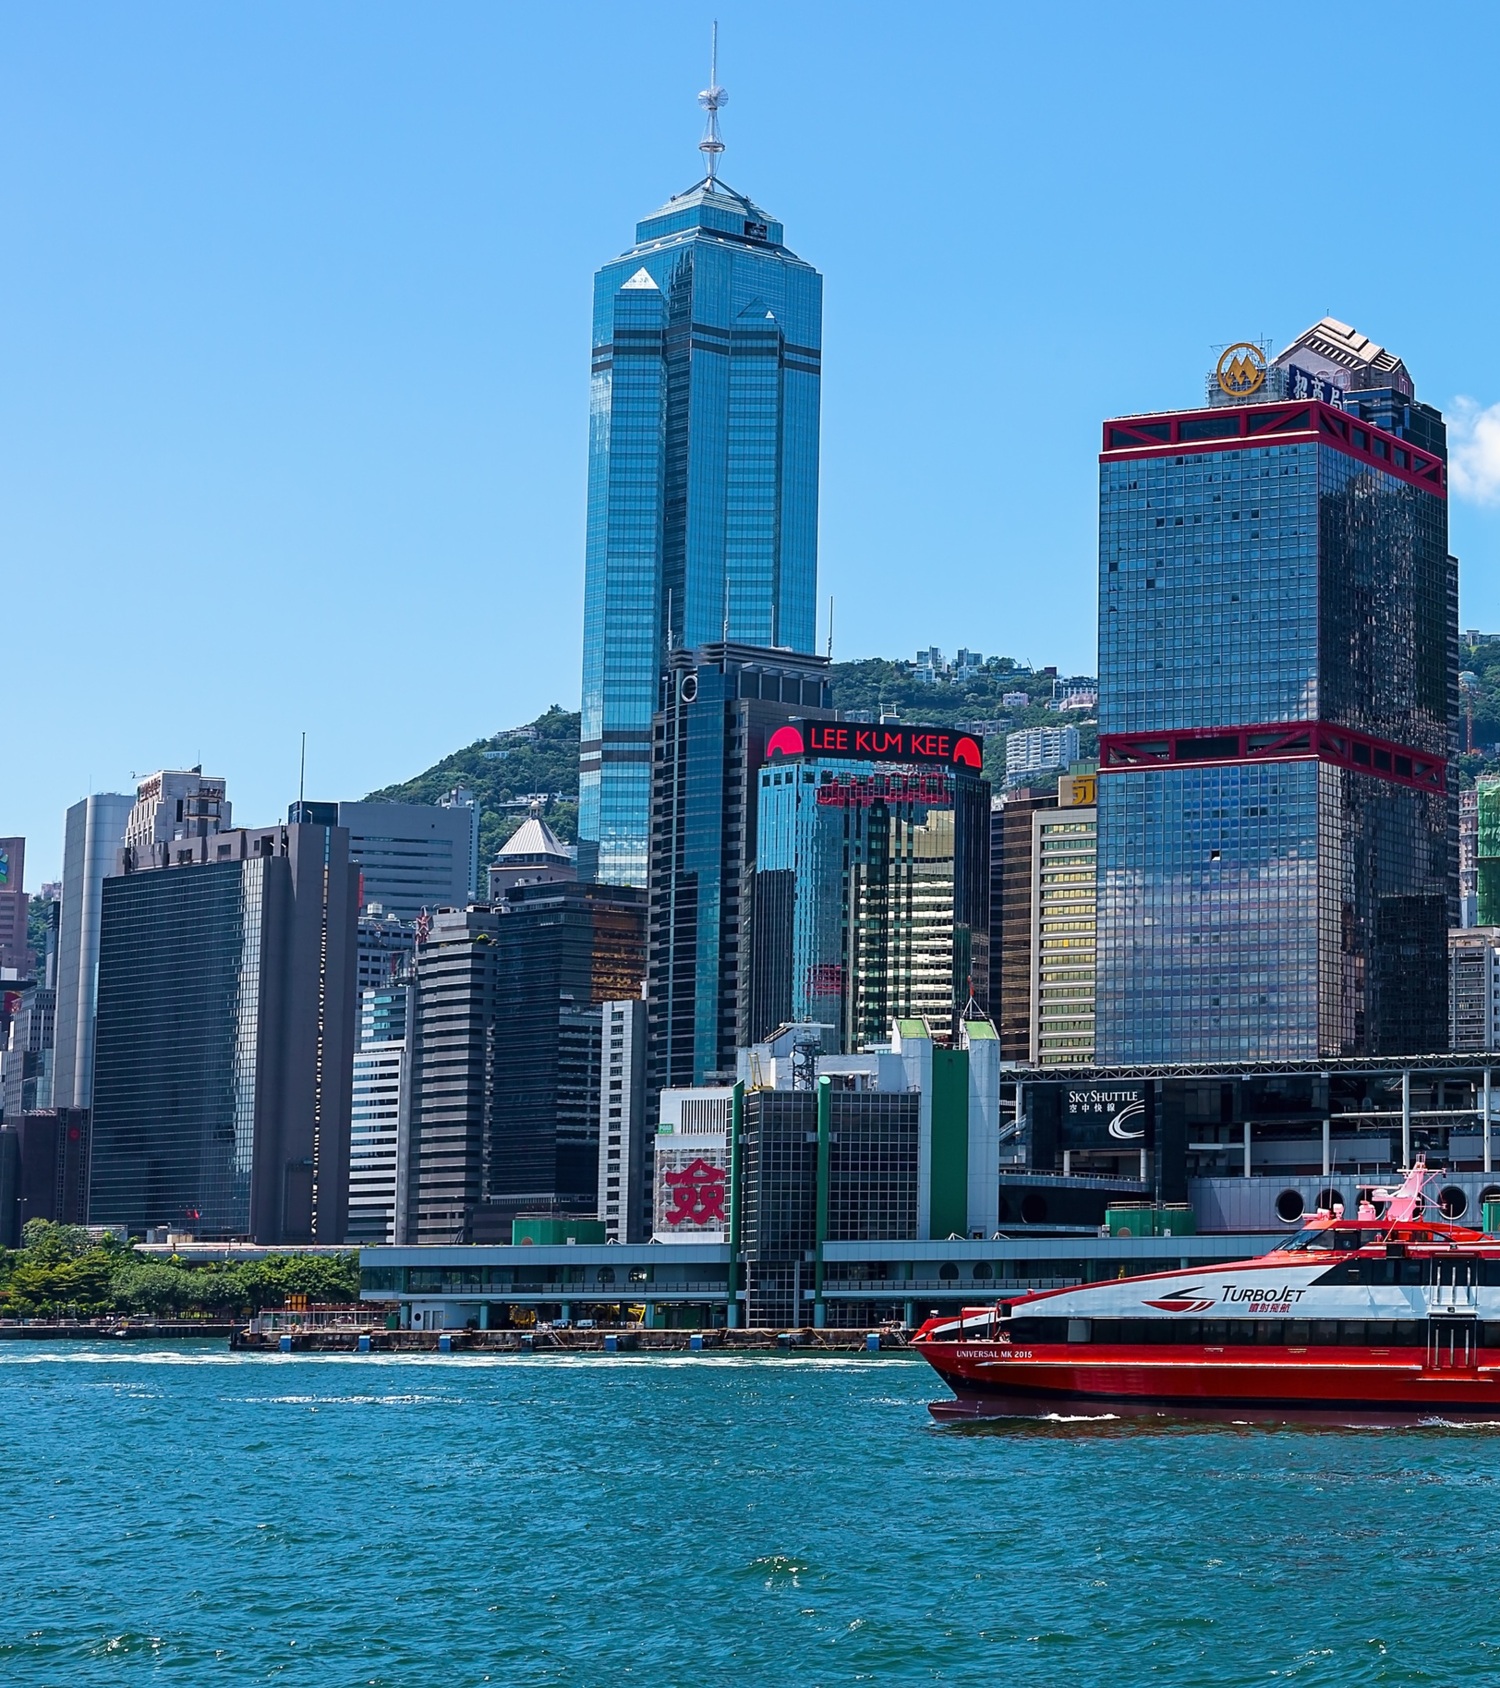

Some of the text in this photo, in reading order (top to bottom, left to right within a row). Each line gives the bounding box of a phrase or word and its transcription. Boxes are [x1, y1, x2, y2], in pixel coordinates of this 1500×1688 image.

[1293, 369, 1343, 410] 招商局
[811, 728, 950, 757] LEE KUM KEE
[956, 1350, 999, 1358] UNIVERSAL
[1000, 1350, 1013, 1358] MK
